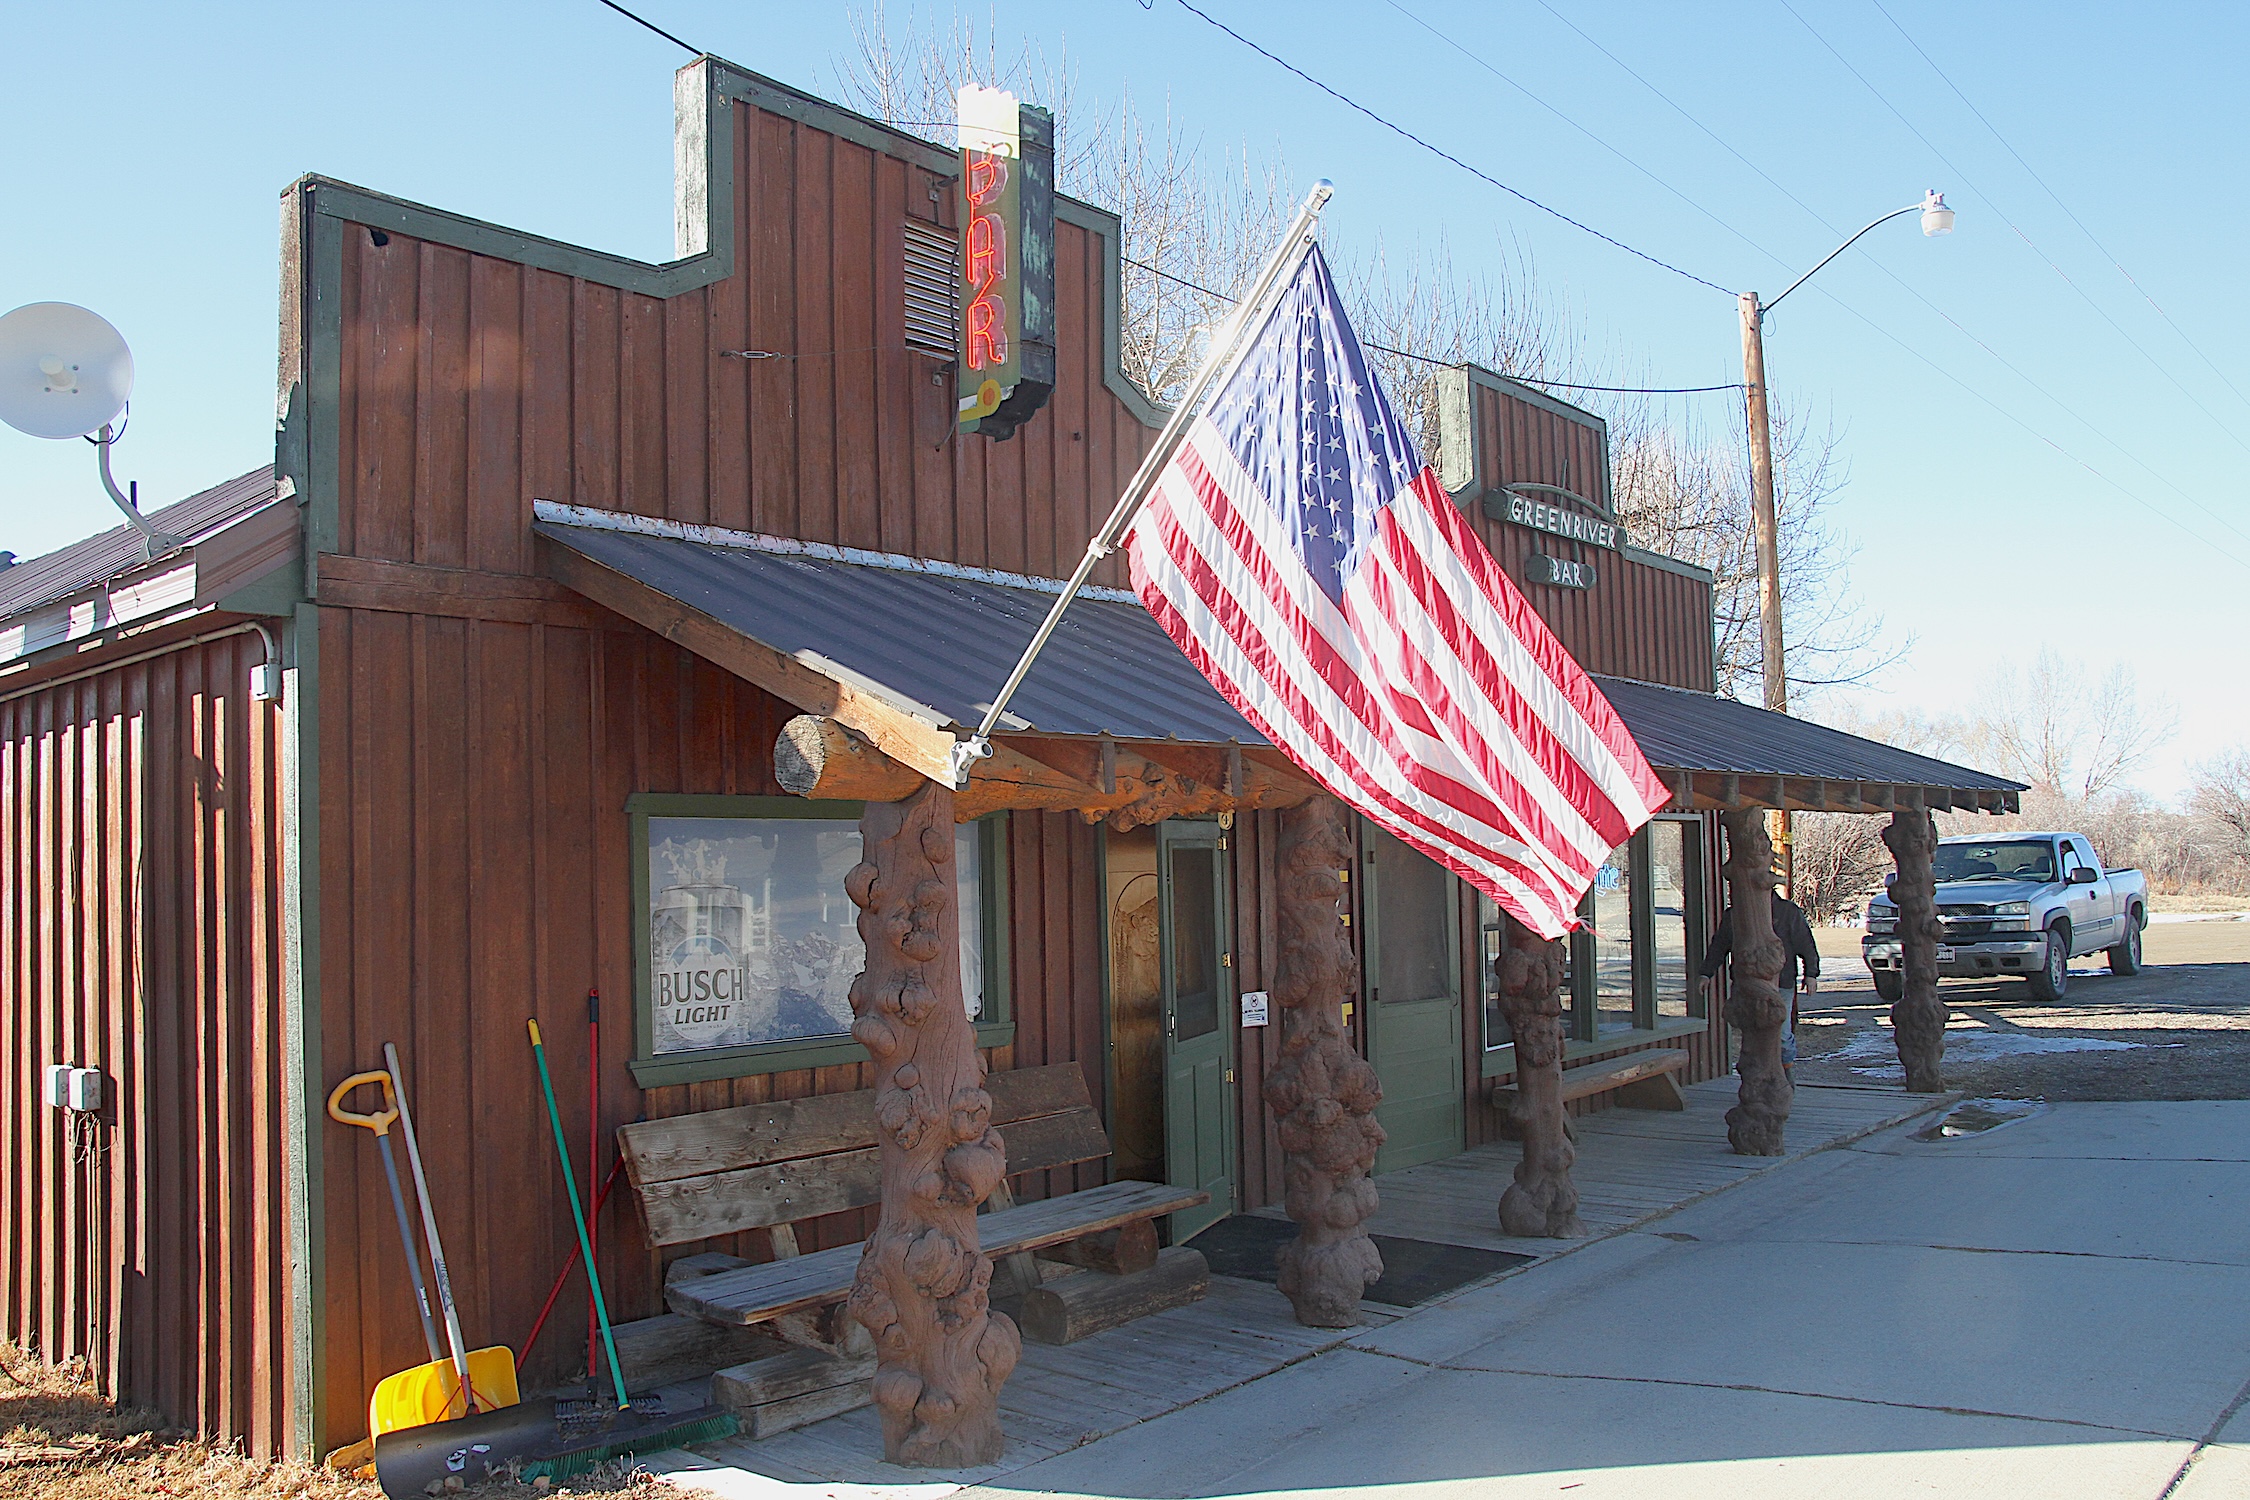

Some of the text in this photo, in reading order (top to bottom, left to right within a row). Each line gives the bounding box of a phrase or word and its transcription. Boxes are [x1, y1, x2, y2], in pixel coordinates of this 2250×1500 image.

[964, 140, 1013, 371] BAR
[1551, 558, 1584, 587] BAR
[659, 968, 744, 1008] BUSCH
[674, 1005, 731, 1025] LIGHT
